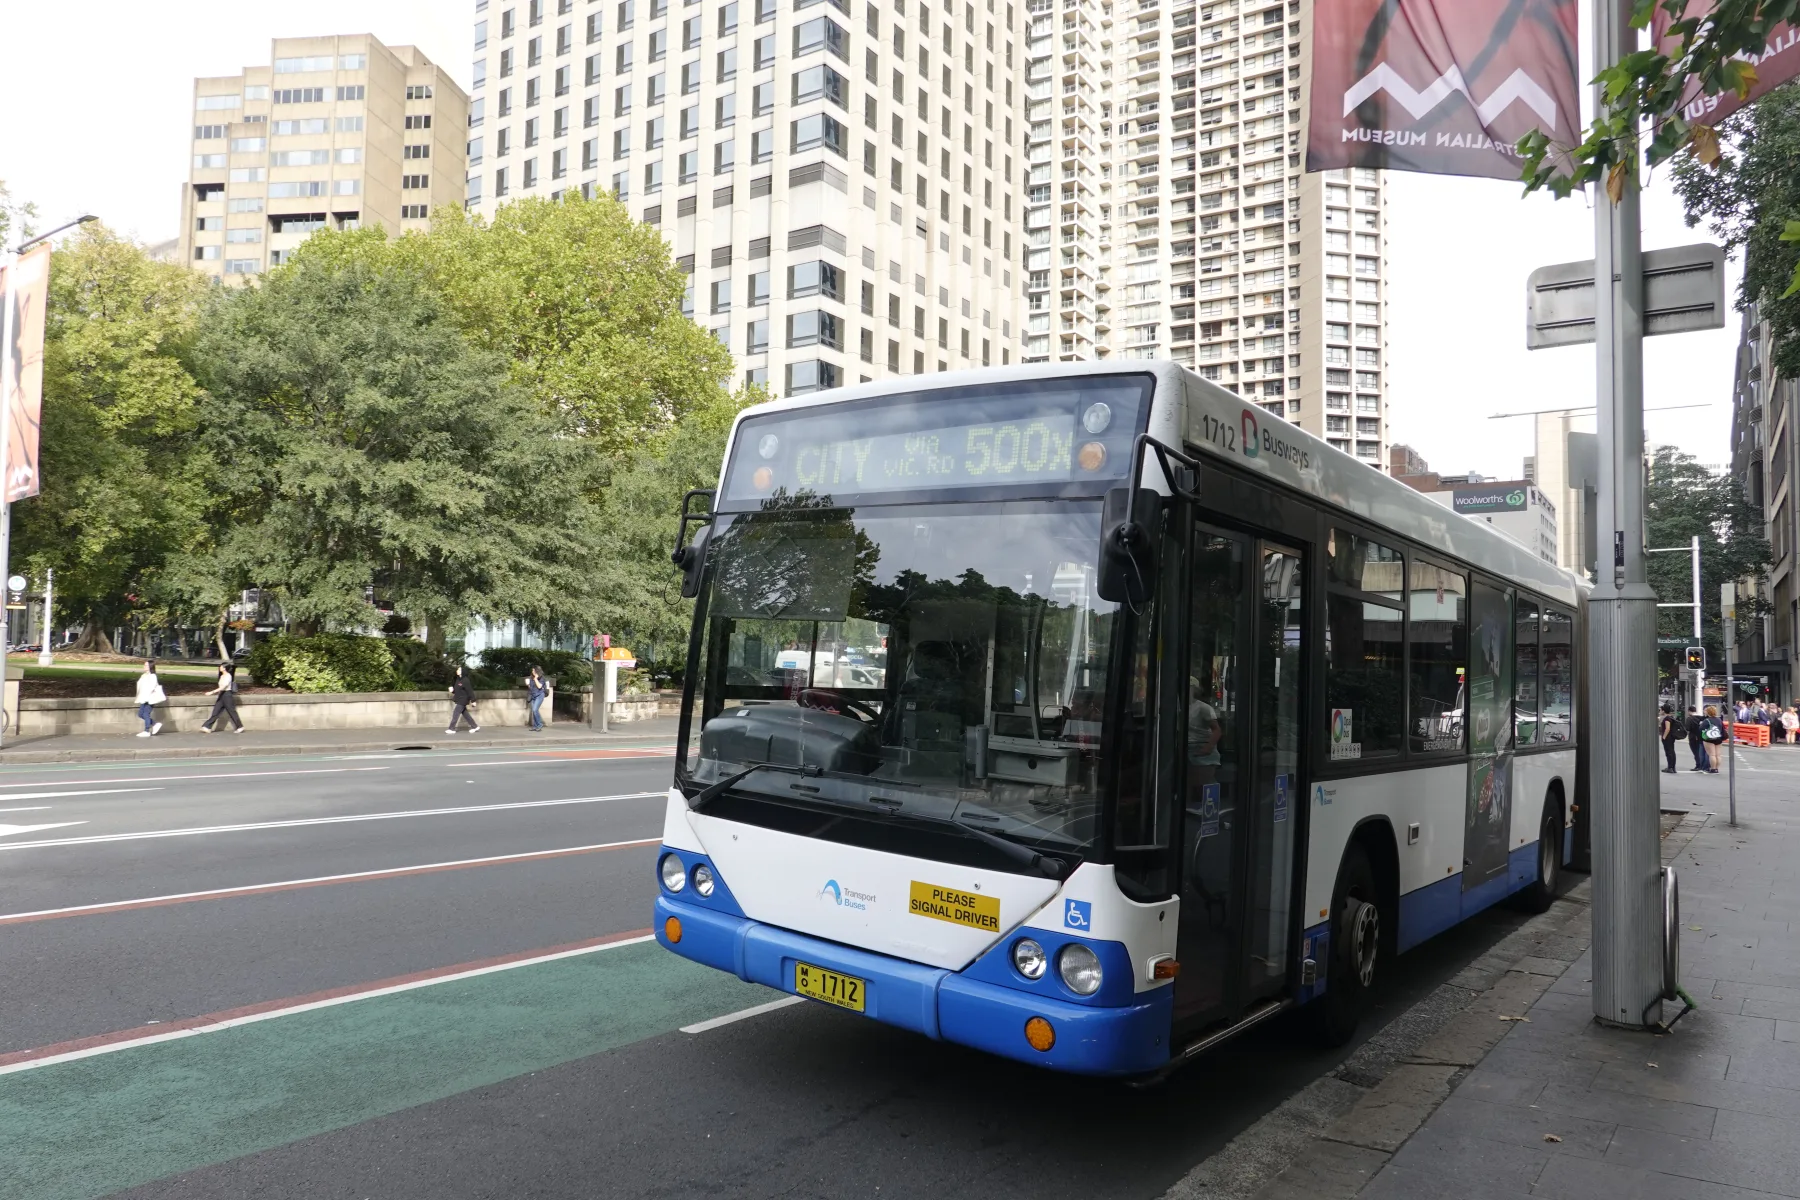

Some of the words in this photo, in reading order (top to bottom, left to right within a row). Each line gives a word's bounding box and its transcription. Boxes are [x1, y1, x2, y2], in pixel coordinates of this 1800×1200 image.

[1203, 414, 1236, 452] 1712
[904, 435, 939, 454] VIA
[1263, 428, 1309, 471] Busways
[796, 439, 874, 485] CITY
[927, 454, 954, 475] RD
[844, 887, 876, 903] Transport
[844, 899, 866, 911] Buses
[932, 889, 976, 909] PLEASE
[911, 899, 952, 918] SIGNAL
[954, 909, 998, 928] DRIVER
[822, 973, 858, 1003] 1712
[805, 989, 816, 997] NEW
[818, 993, 835, 1003] SOUTH
[836, 999, 854, 1009] WALES
